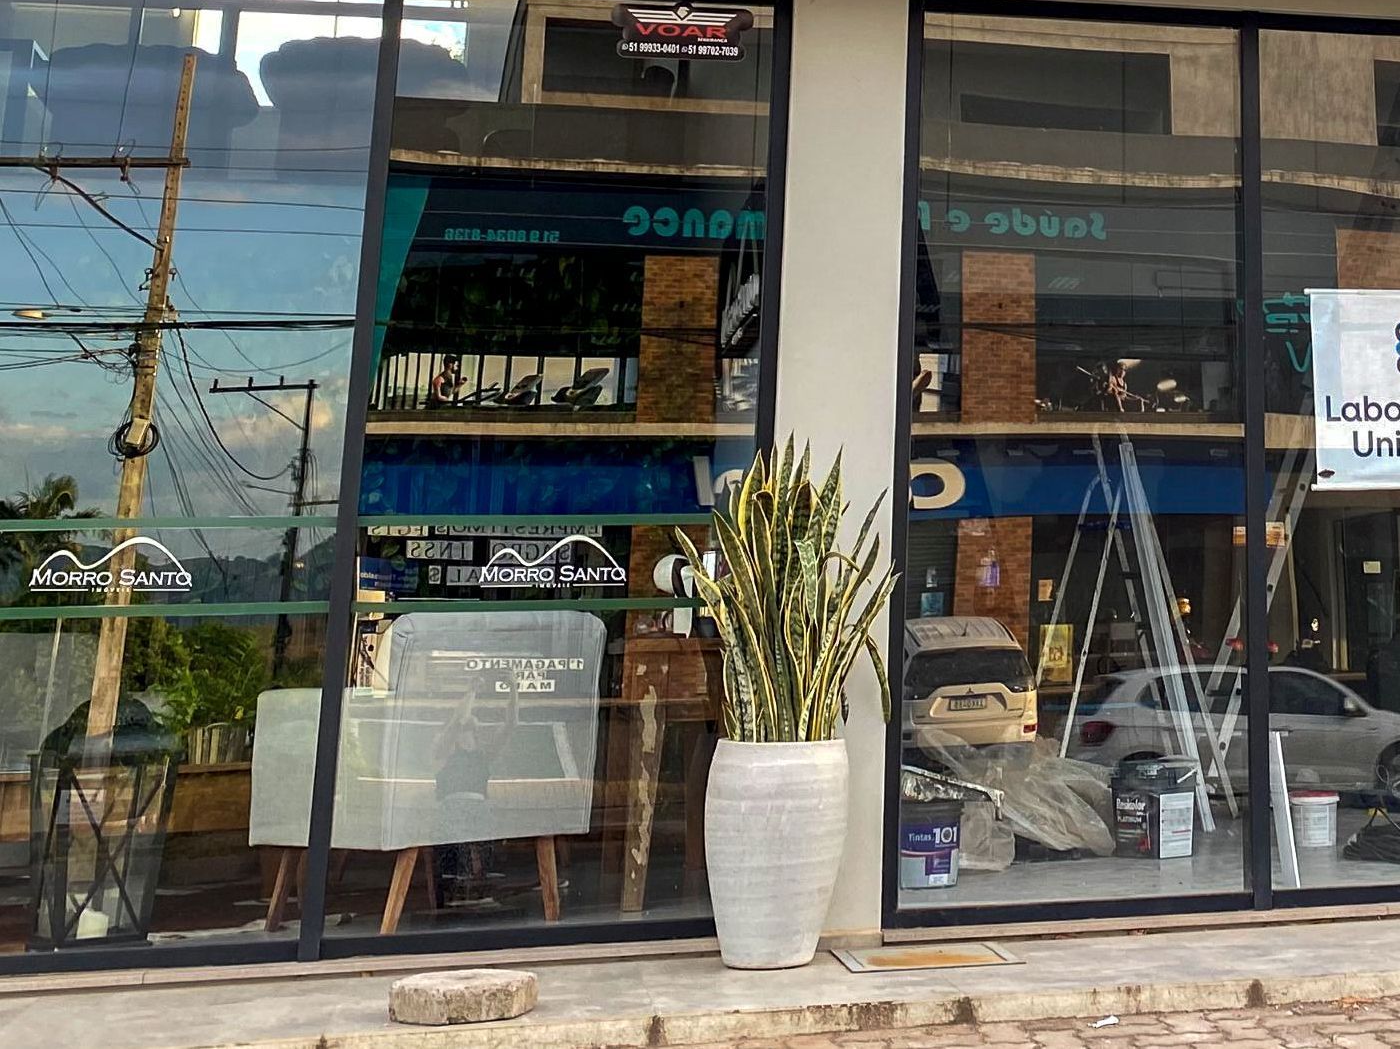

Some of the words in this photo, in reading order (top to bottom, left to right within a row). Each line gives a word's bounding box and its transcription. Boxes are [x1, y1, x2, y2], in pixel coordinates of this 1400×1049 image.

[635, 22, 727, 38] VOAR
[628, 42, 638, 52] 51
[688, 44, 697, 55] 51
[29, 568, 113, 587] MORRO
[118, 568, 192, 587] SANTO
[480, 565, 555, 583] MORRO
[559, 564, 627, 582] SANTO
[933, 826, 958, 844] 101
